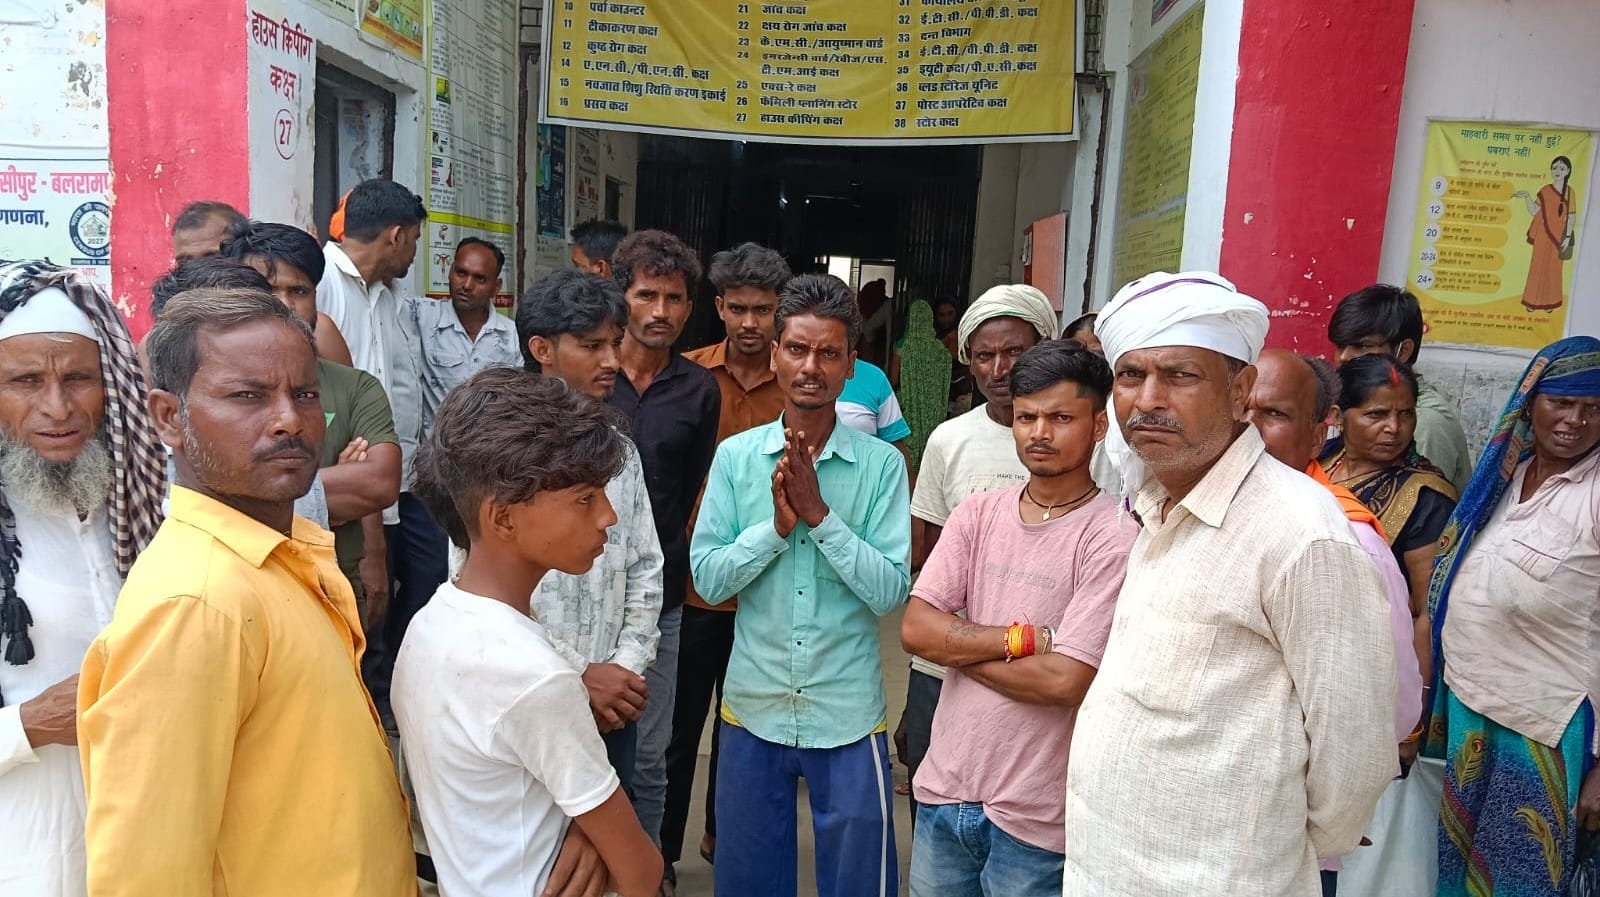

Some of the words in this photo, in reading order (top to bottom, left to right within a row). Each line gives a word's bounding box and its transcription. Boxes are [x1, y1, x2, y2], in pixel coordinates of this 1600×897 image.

[564, 2, 574, 10] 10
[738, 4, 748, 13] 21
[762, 4, 783, 14] जांच
[786, 5, 806, 15] कक्ष
[898, 15, 910, 24] 32
[1017, 8, 1038, 17] कक्ष
[252, 10, 280, 49] हाउस
[564, 19, 572, 28] 11
[588, 19, 636, 34] टीकाकरण
[638, 26, 659, 36] कक्ष
[738, 21, 749, 30] 22
[762, 22, 780, 31] क्षय
[783, 20, 800, 32] रोग
[802, 21, 824, 32] जांच
[826, 23, 847, 32] कक्ष
[738, 37, 749, 46] 23
[866, 37, 884, 48] वार्ड
[897, 33, 910, 42] 33
[562, 41, 571, 50] 12
[608, 40, 625, 53] रोग
[628, 44, 648, 54] कक्ष
[898, 50, 909, 59] 34
[1017, 44, 1037, 53] कक्ष
[737, 51, 748, 59] 24
[561, 58, 570, 67] 14
[691, 69, 710, 80] कक्ष
[819, 67, 840, 77] कक्ष
[897, 66, 909, 74] 35
[270, 64, 297, 100] कक्ष
[736, 81, 748, 89] 25
[796, 83, 817, 93] कक्ष
[896, 82, 908, 92] 36
[972, 78, 998, 93] यूनिट
[560, 78, 569, 87] 15
[585, 79, 619, 92] नवजात
[622, 80, 643, 97] शिशु
[675, 88, 699, 100] करण
[701, 88, 727, 103] इकाई
[560, 97, 568, 106] 16
[584, 98, 606, 110] प्रसव
[608, 101, 629, 112] कक्ष
[736, 97, 748, 106] 26
[837, 98, 859, 110] स्टोर
[895, 101, 906, 110] 37
[917, 98, 939, 110] पोस्ट
[987, 98, 1008, 108] कक्ष
[736, 113, 746, 123] 27
[760, 113, 785, 124] हाउस
[823, 115, 844, 126] कक्ष
[894, 118, 906, 128] 38
[916, 115, 937, 128] स्टोर
[939, 117, 960, 127] कक्ष
[279, 119, 292, 145] 27
[1435, 181, 1442, 190] 9
[1430, 205, 1441, 214] 12
[1426, 228, 1438, 238] 20
[1417, 274, 1433, 284] 24+
